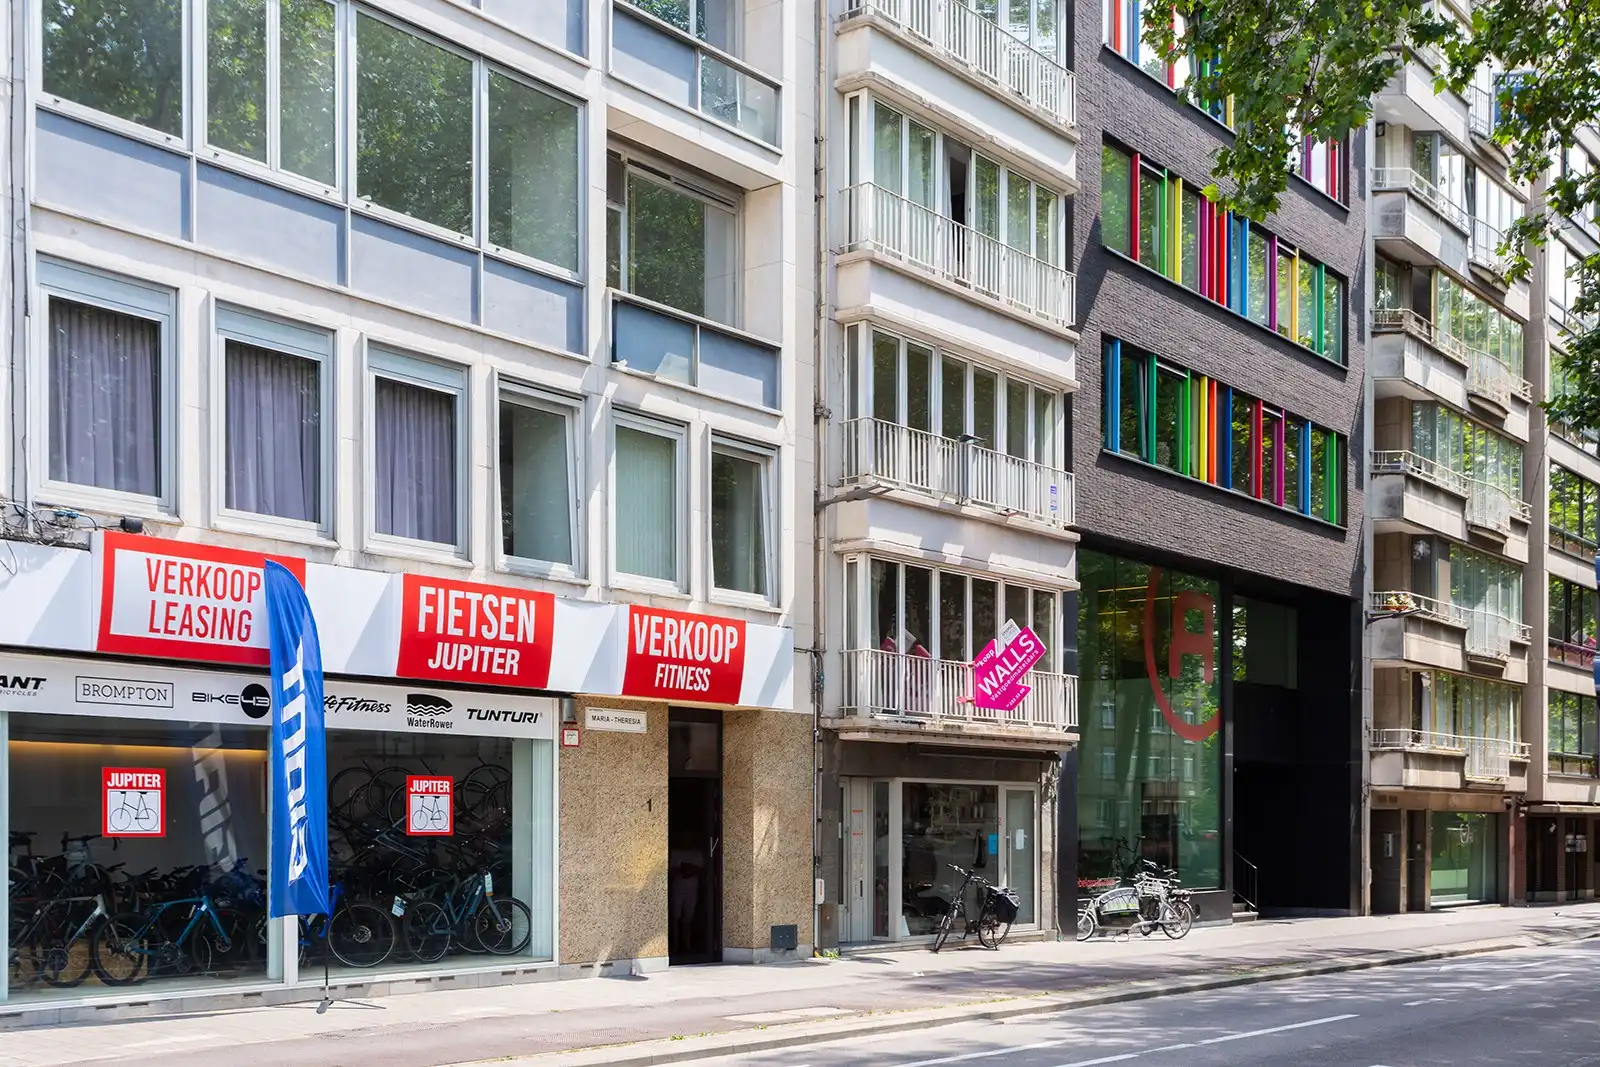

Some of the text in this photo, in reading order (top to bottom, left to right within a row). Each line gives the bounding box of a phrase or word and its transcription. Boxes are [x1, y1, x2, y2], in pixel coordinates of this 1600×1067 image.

[146, 558, 261, 603] VERKOOP
[148, 600, 252, 642] LEASING
[418, 586, 536, 643] FIETSEN
[633, 613, 739, 664] VERKOOP
[428, 642, 520, 676] JUPITER
[978, 634, 1035, 696] WALLS
[82, 684, 168, 701] BROMPTON
[654, 664, 711, 692] FITNESS
[406, 717, 453, 729] WaterRower
[467, 708, 539, 724] TUNTURI
[107, 772, 161, 788] JUPITER
[410, 779, 450, 793] JUPITER
